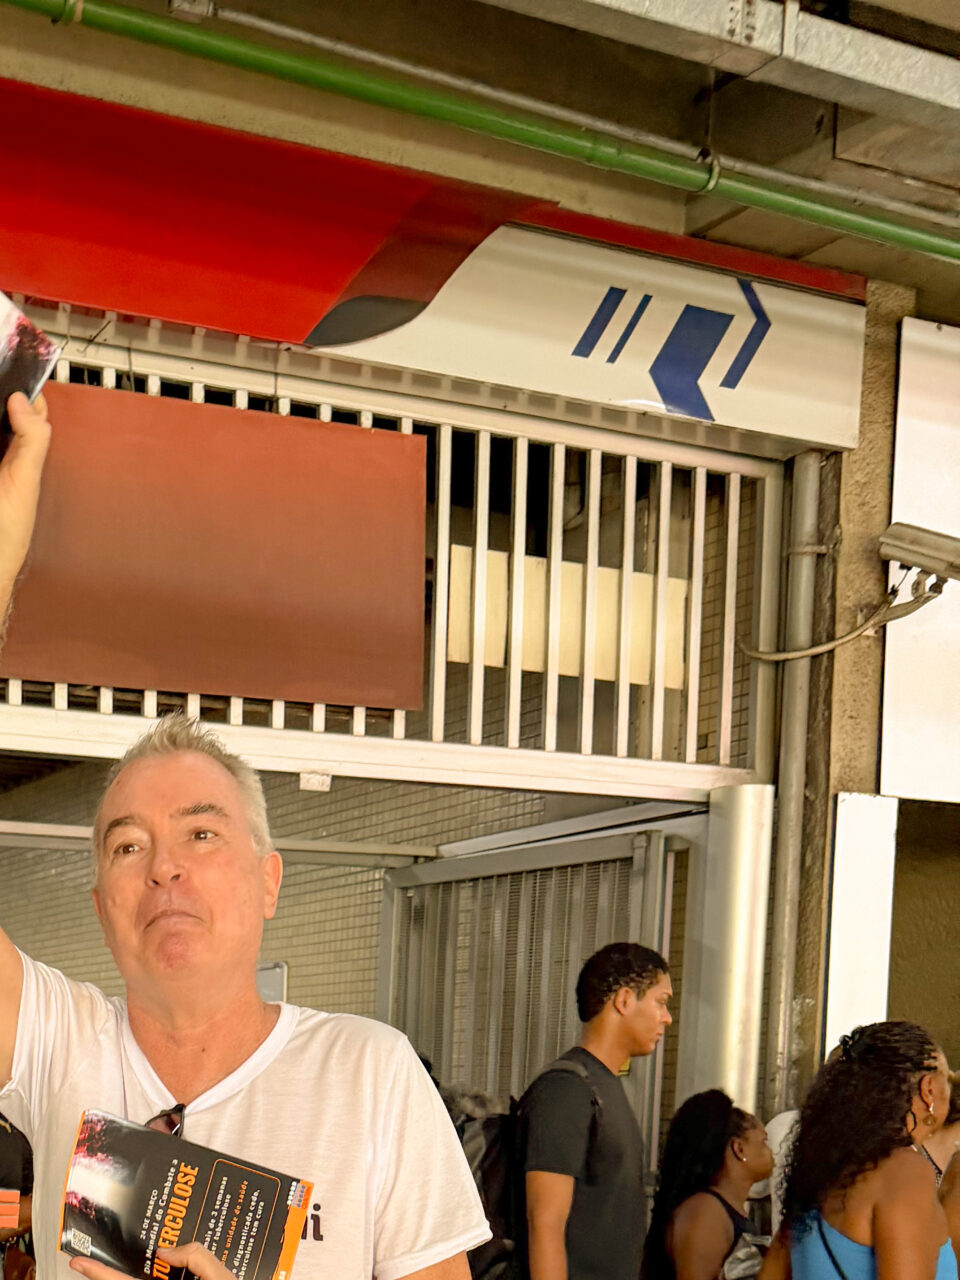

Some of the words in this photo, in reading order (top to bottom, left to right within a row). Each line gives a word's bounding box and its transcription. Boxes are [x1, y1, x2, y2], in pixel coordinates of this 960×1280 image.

[158, 1166, 176, 1206] Combate
[236, 1179, 248, 1203] saúde
[145, 1188, 159, 1217] MARÇO
[154, 1208, 163, 1220] do
[207, 1218, 216, 1228] de
[213, 1175, 228, 1209] semanas
[233, 1204, 241, 1214] de
[254, 1200, 264, 1218] cura
[142, 1218, 150, 1229] DE
[151, 1161, 198, 1280] TUERCULOSE
[212, 1193, 231, 1240] tuberculose
[250, 1220, 259, 1236] tem
[139, 1229, 147, 1240] 24
[145, 1222, 160, 1258] Mundial
[223, 1216, 238, 1248] unidade
[232, 1211, 254, 1266] diagnosticada
[143, 1259, 152, 1274] Dia
